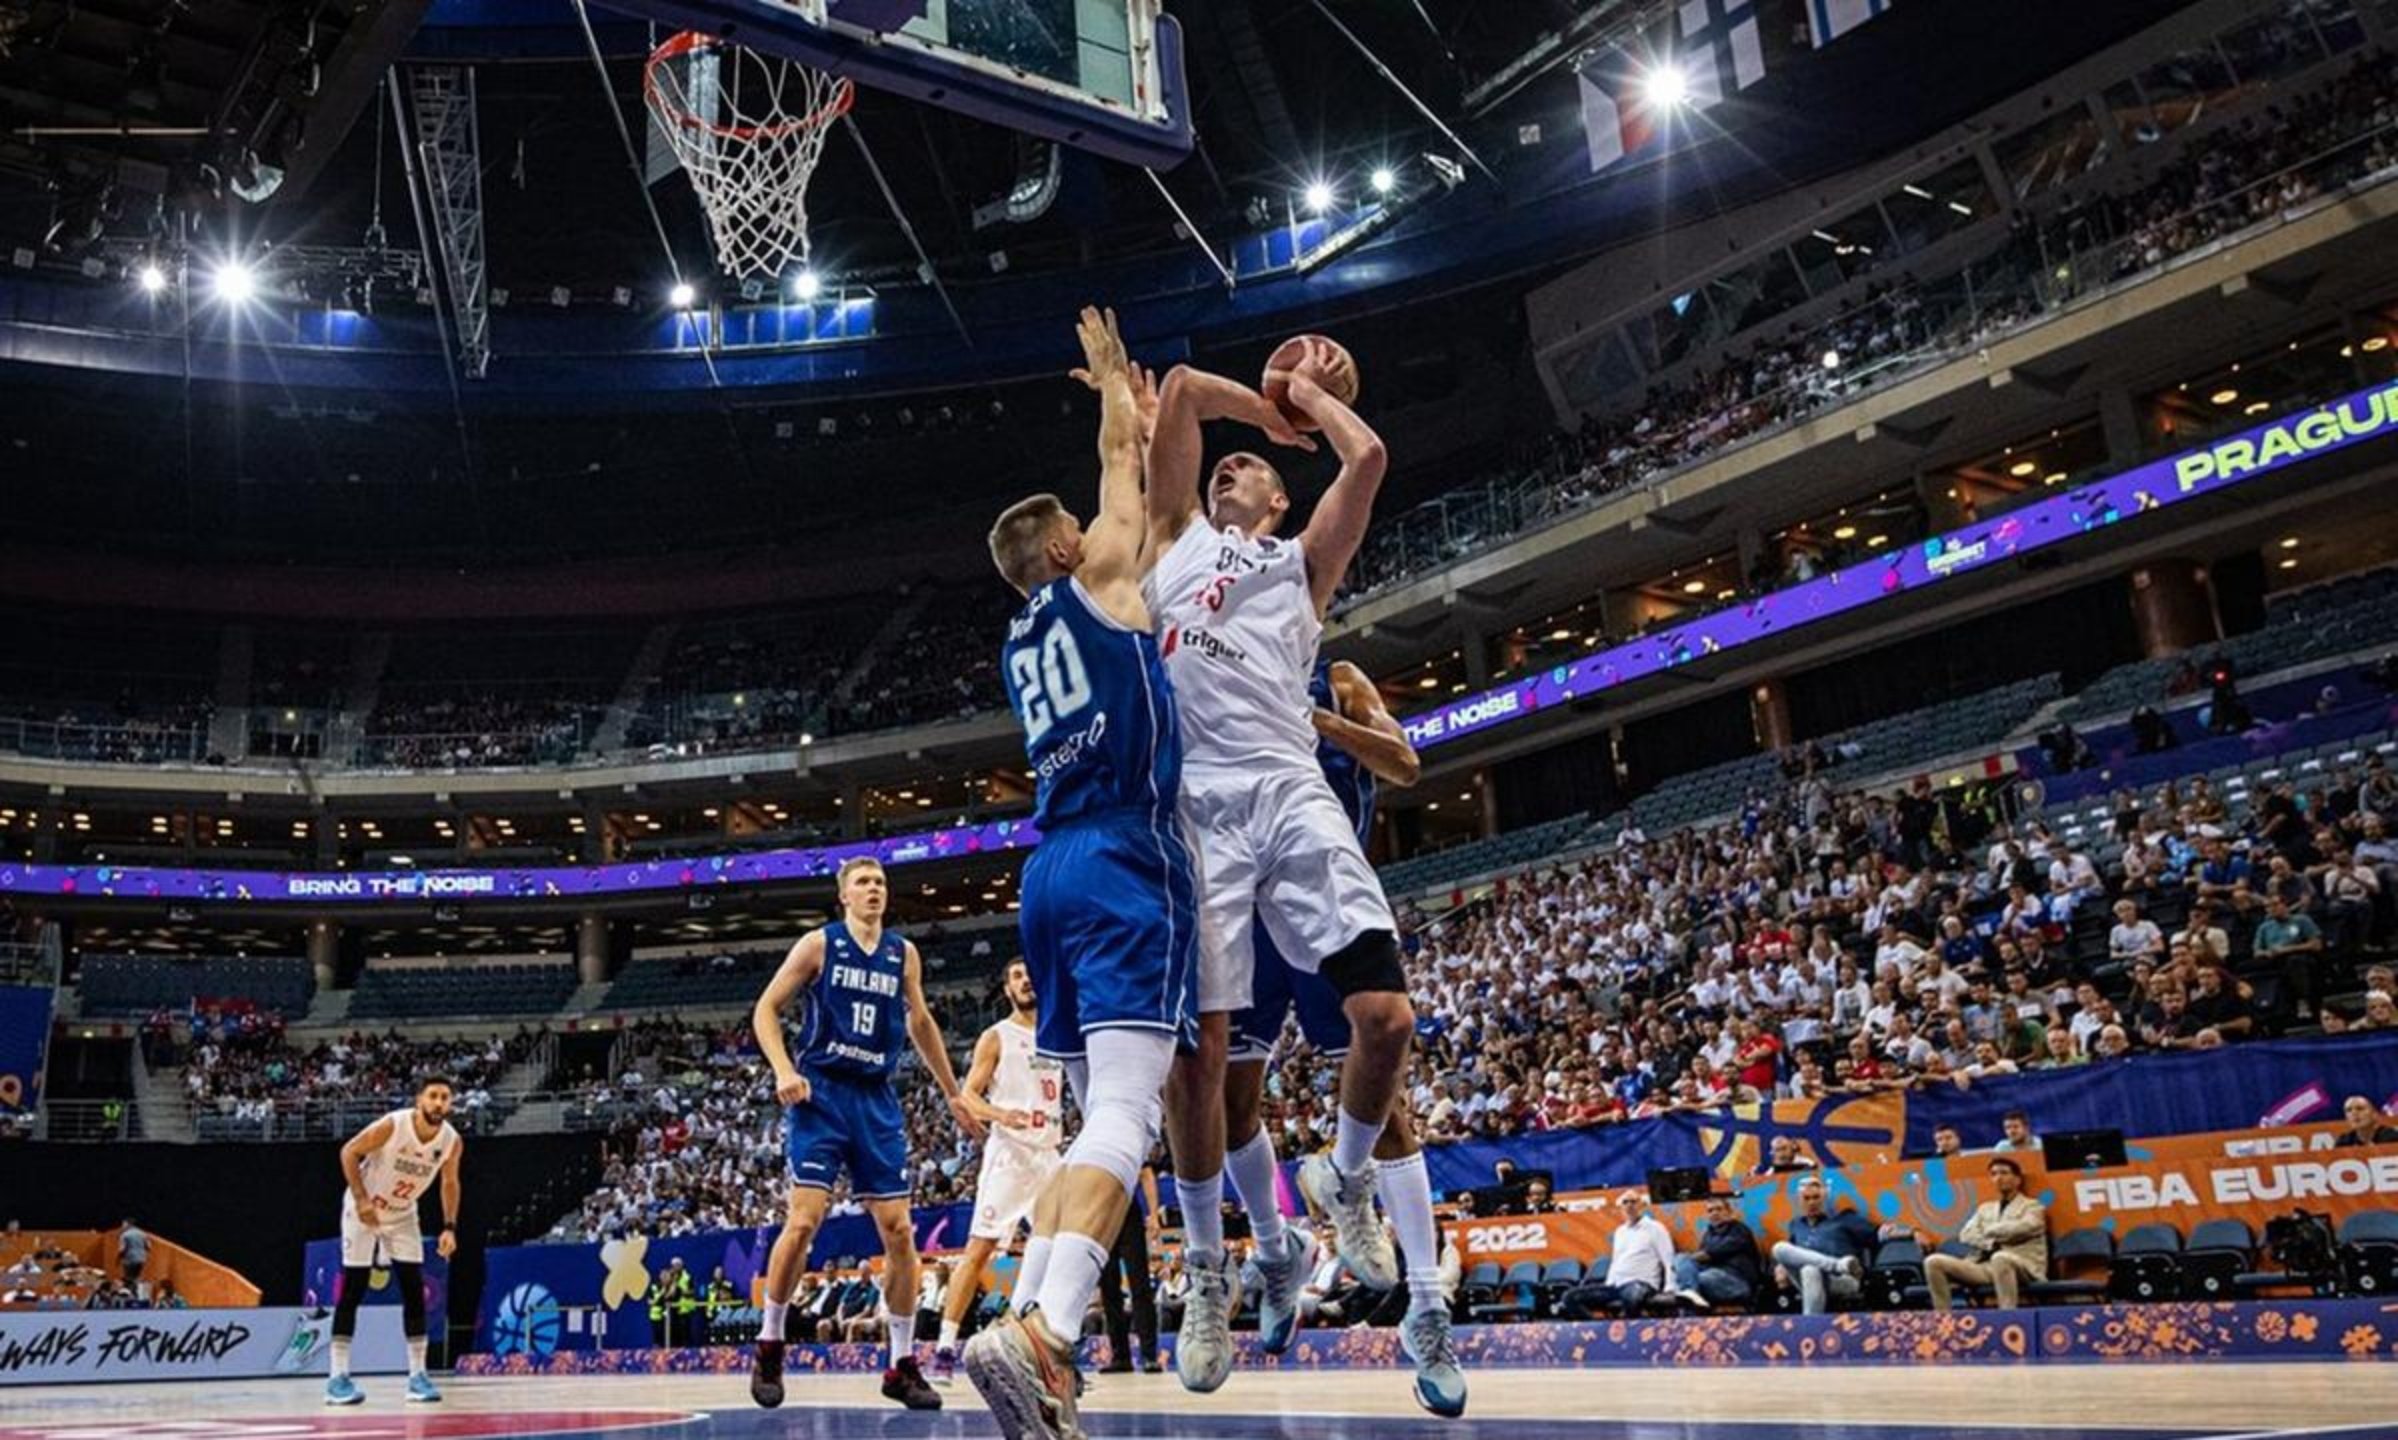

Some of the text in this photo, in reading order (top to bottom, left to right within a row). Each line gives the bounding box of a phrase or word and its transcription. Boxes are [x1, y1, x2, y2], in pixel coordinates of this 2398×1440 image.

[1010, 617, 1092, 746] 20
[1402, 690, 1518, 742] THE NOISE
[288, 876, 494, 894] BRING THE NOISE
[831, 964, 899, 998] FINLAND
[851, 1001, 877, 1036] 19
[2074, 1172, 2199, 1212] FIBA
[1467, 1223, 1547, 1253] 2022
[0, 1320, 250, 1371] WAYS FORWARD
